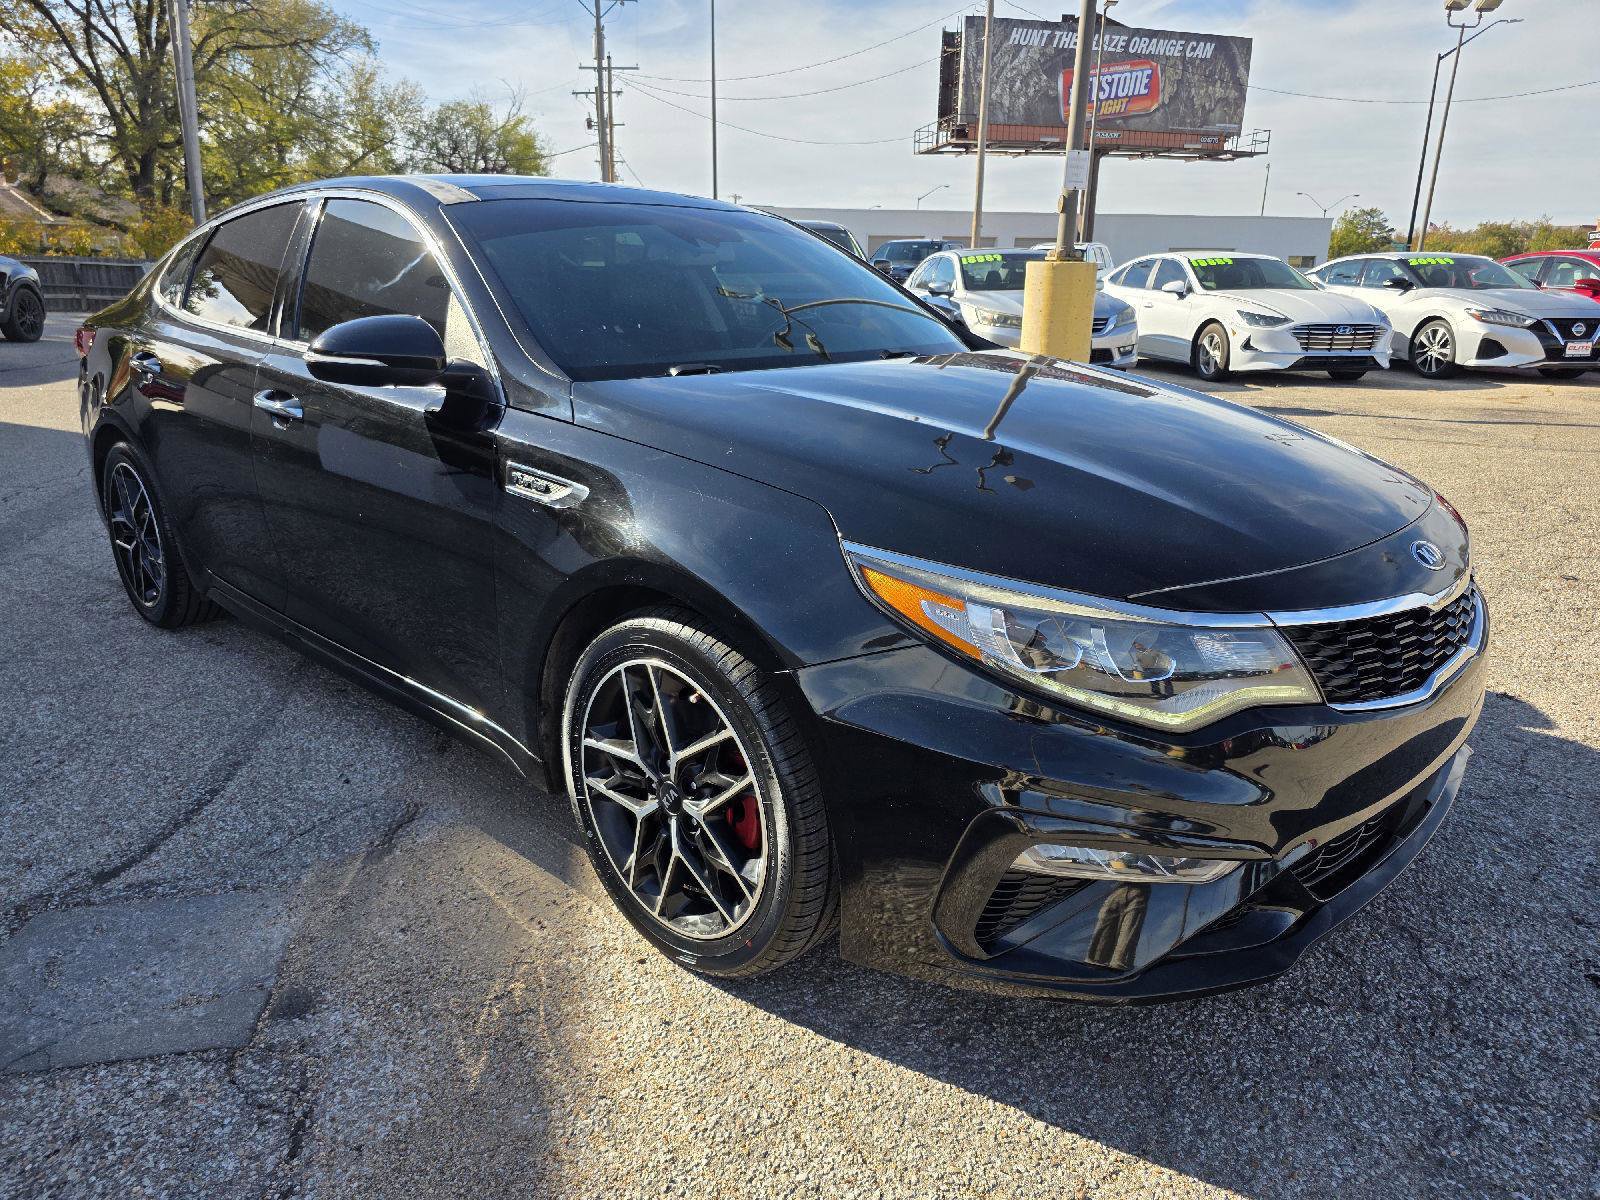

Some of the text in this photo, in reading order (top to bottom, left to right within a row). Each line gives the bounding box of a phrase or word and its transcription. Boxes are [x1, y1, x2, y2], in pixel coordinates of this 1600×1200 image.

[1008, 27, 1051, 47] HUNT
[1052, 30, 1079, 49] THE
[1128, 36, 1185, 57] ORANGE
[1185, 41, 1216, 59] CAN
[1097, 98, 1129, 116] IGHT
